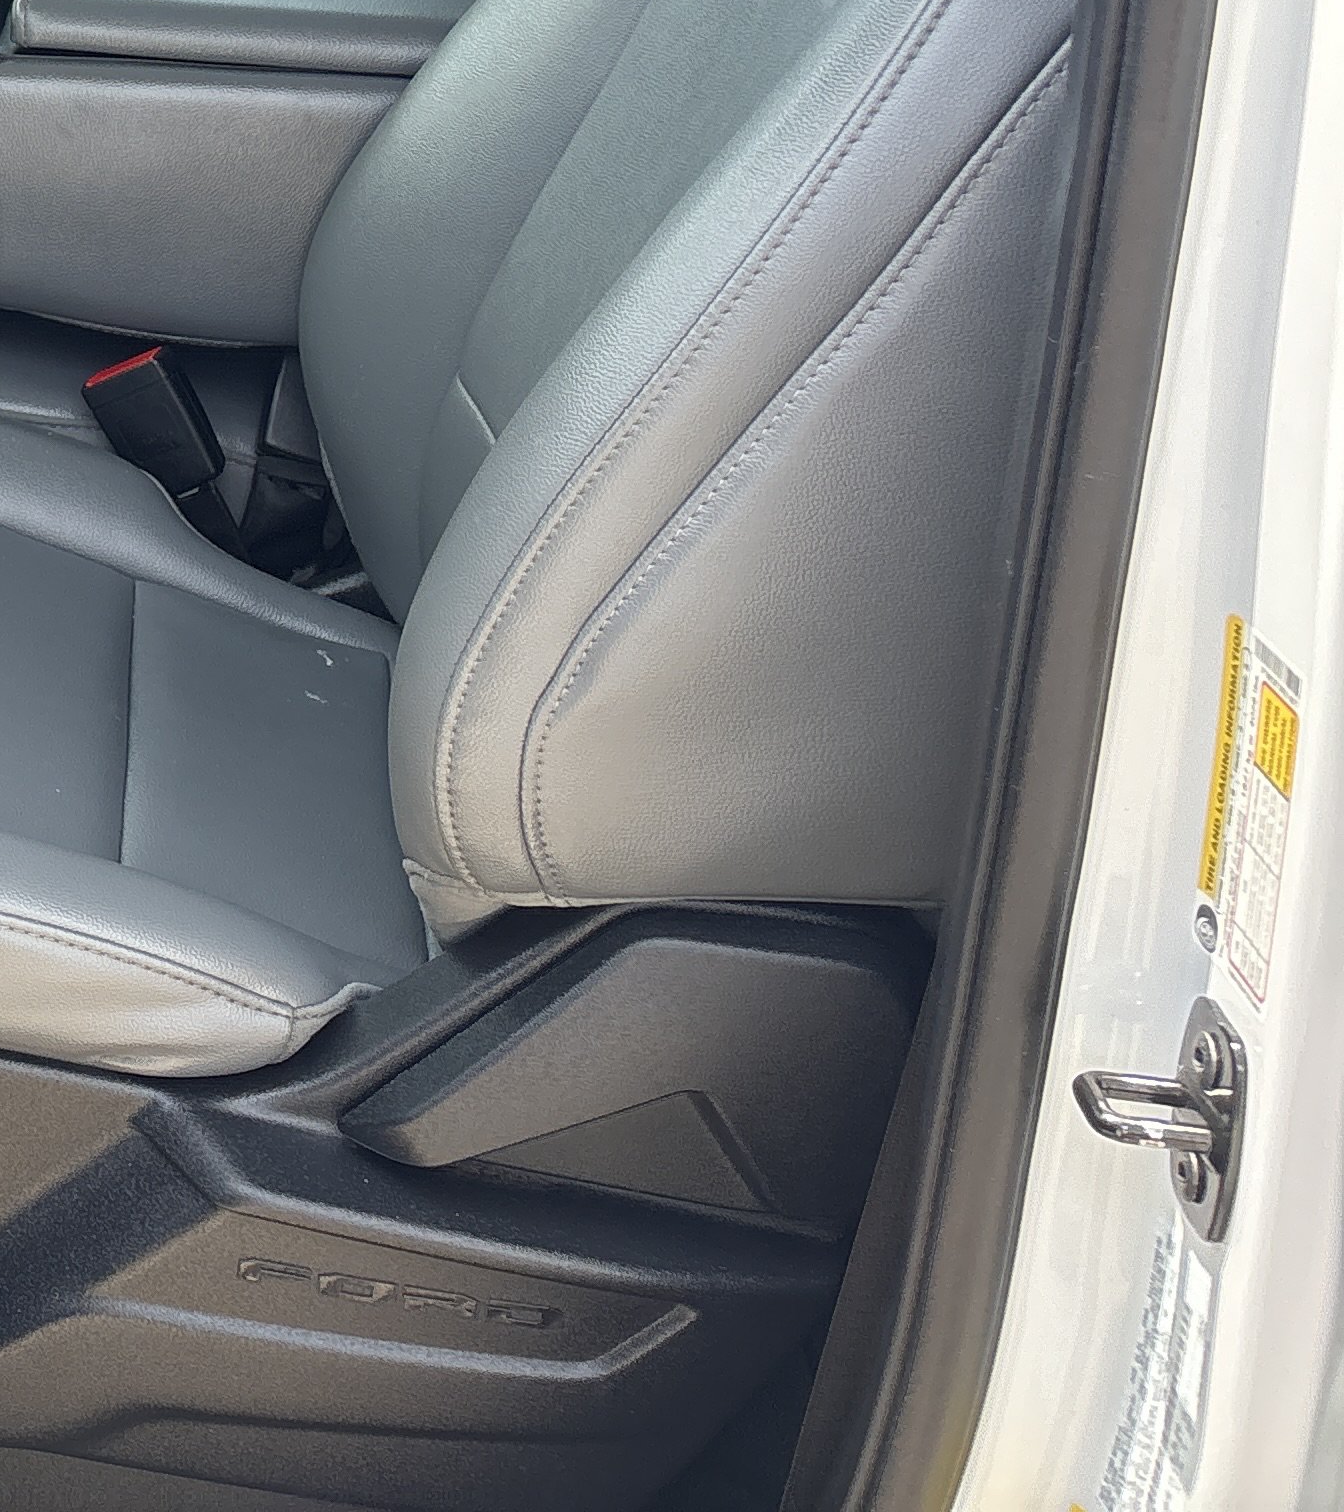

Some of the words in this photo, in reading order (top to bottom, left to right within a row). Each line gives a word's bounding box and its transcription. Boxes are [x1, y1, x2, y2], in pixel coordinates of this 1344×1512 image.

[1224, 623, 1243, 737] INFORMATION
[1215, 742, 1231, 813] LOADING
[1210, 818, 1223, 849] AND
[1204, 854, 1216, 892] TIRE
[236, 1256, 564, 1327] FORD
